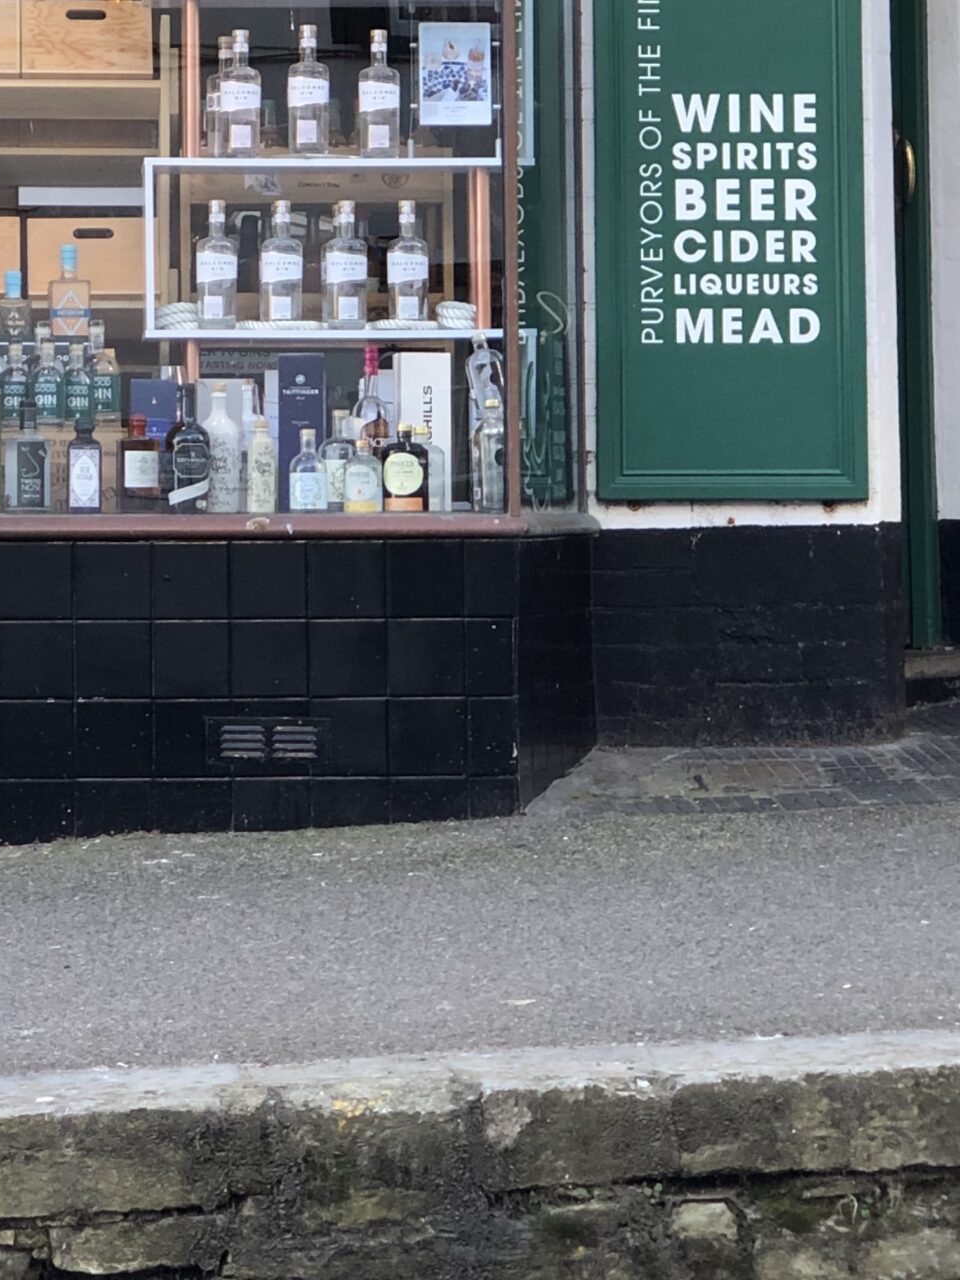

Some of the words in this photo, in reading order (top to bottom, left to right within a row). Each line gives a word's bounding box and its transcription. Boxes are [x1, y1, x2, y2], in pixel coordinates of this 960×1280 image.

[637, 44, 661, 97] THE
[638, 109, 662, 150] OF
[671, 93, 817, 133] WINE
[671, 142, 818, 171] SPIRITS
[674, 178, 817, 221] BEER
[639, 163, 664, 344] PURVEYORS
[673, 229, 817, 263] CIDER
[673, 273, 819, 296] LIQUEURS
[675, 307, 821, 344] MEAD
[34, 398, 57, 407] GIN
[67, 398, 89, 407] GIN
